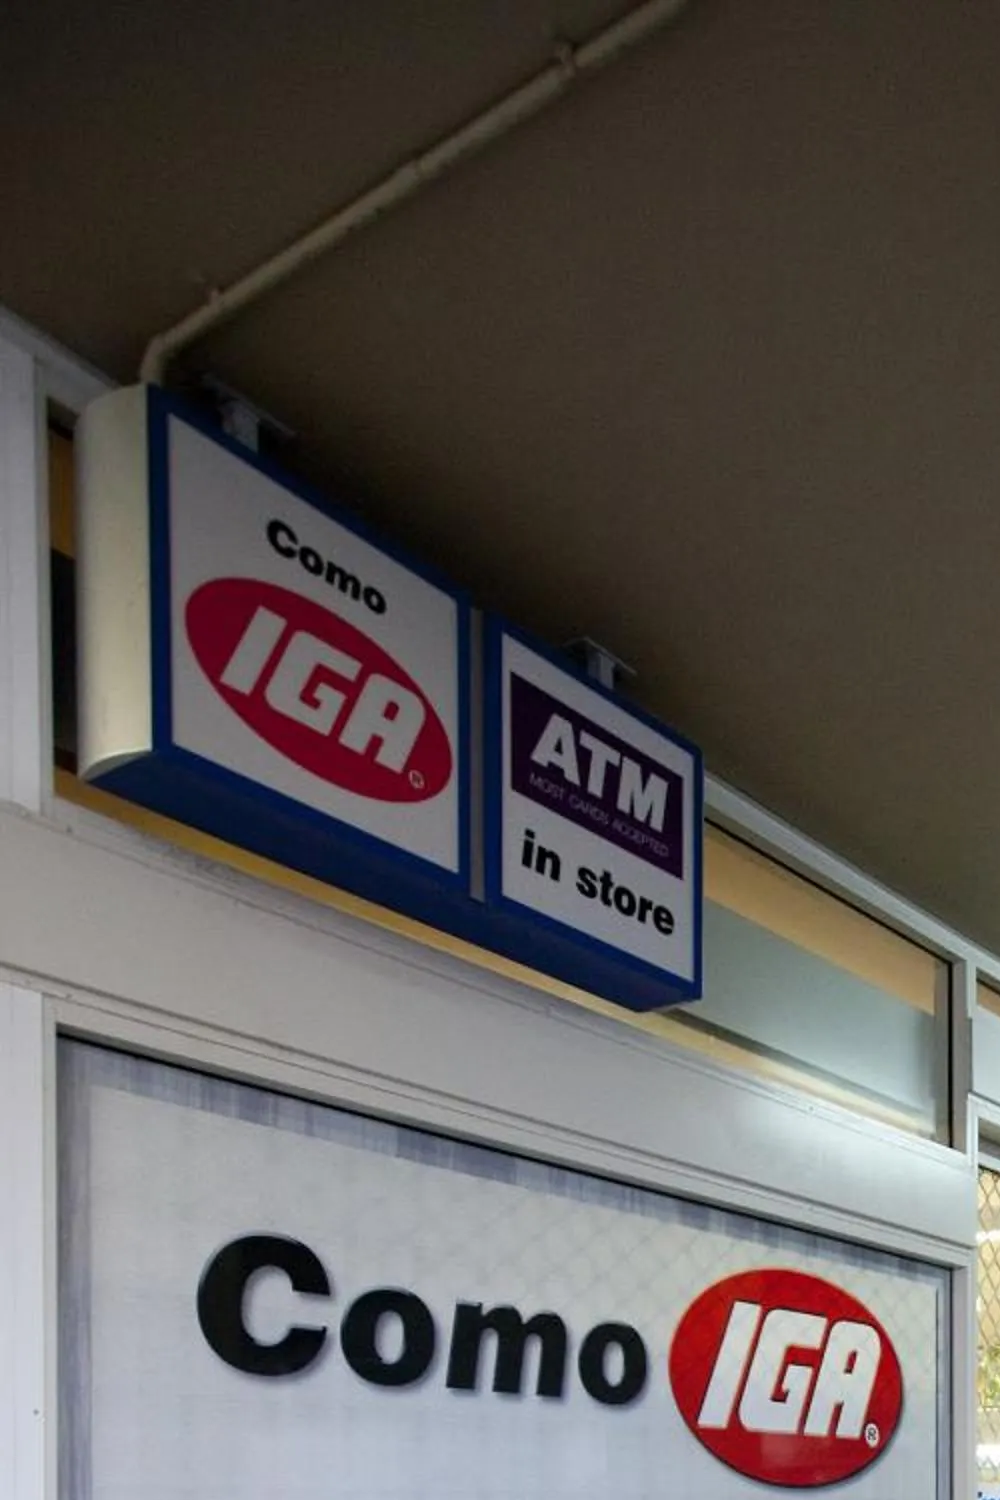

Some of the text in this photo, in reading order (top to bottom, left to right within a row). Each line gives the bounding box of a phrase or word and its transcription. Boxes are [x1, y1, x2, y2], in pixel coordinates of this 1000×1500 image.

[264, 517, 389, 617] Como
[219, 604, 428, 775] IGA
[528, 772, 670, 858] MOST CARDS ACCEPTED
[529, 712, 670, 834] ATM
[520, 828, 676, 936] in store
[196, 1233, 884, 1439] Como IGA
